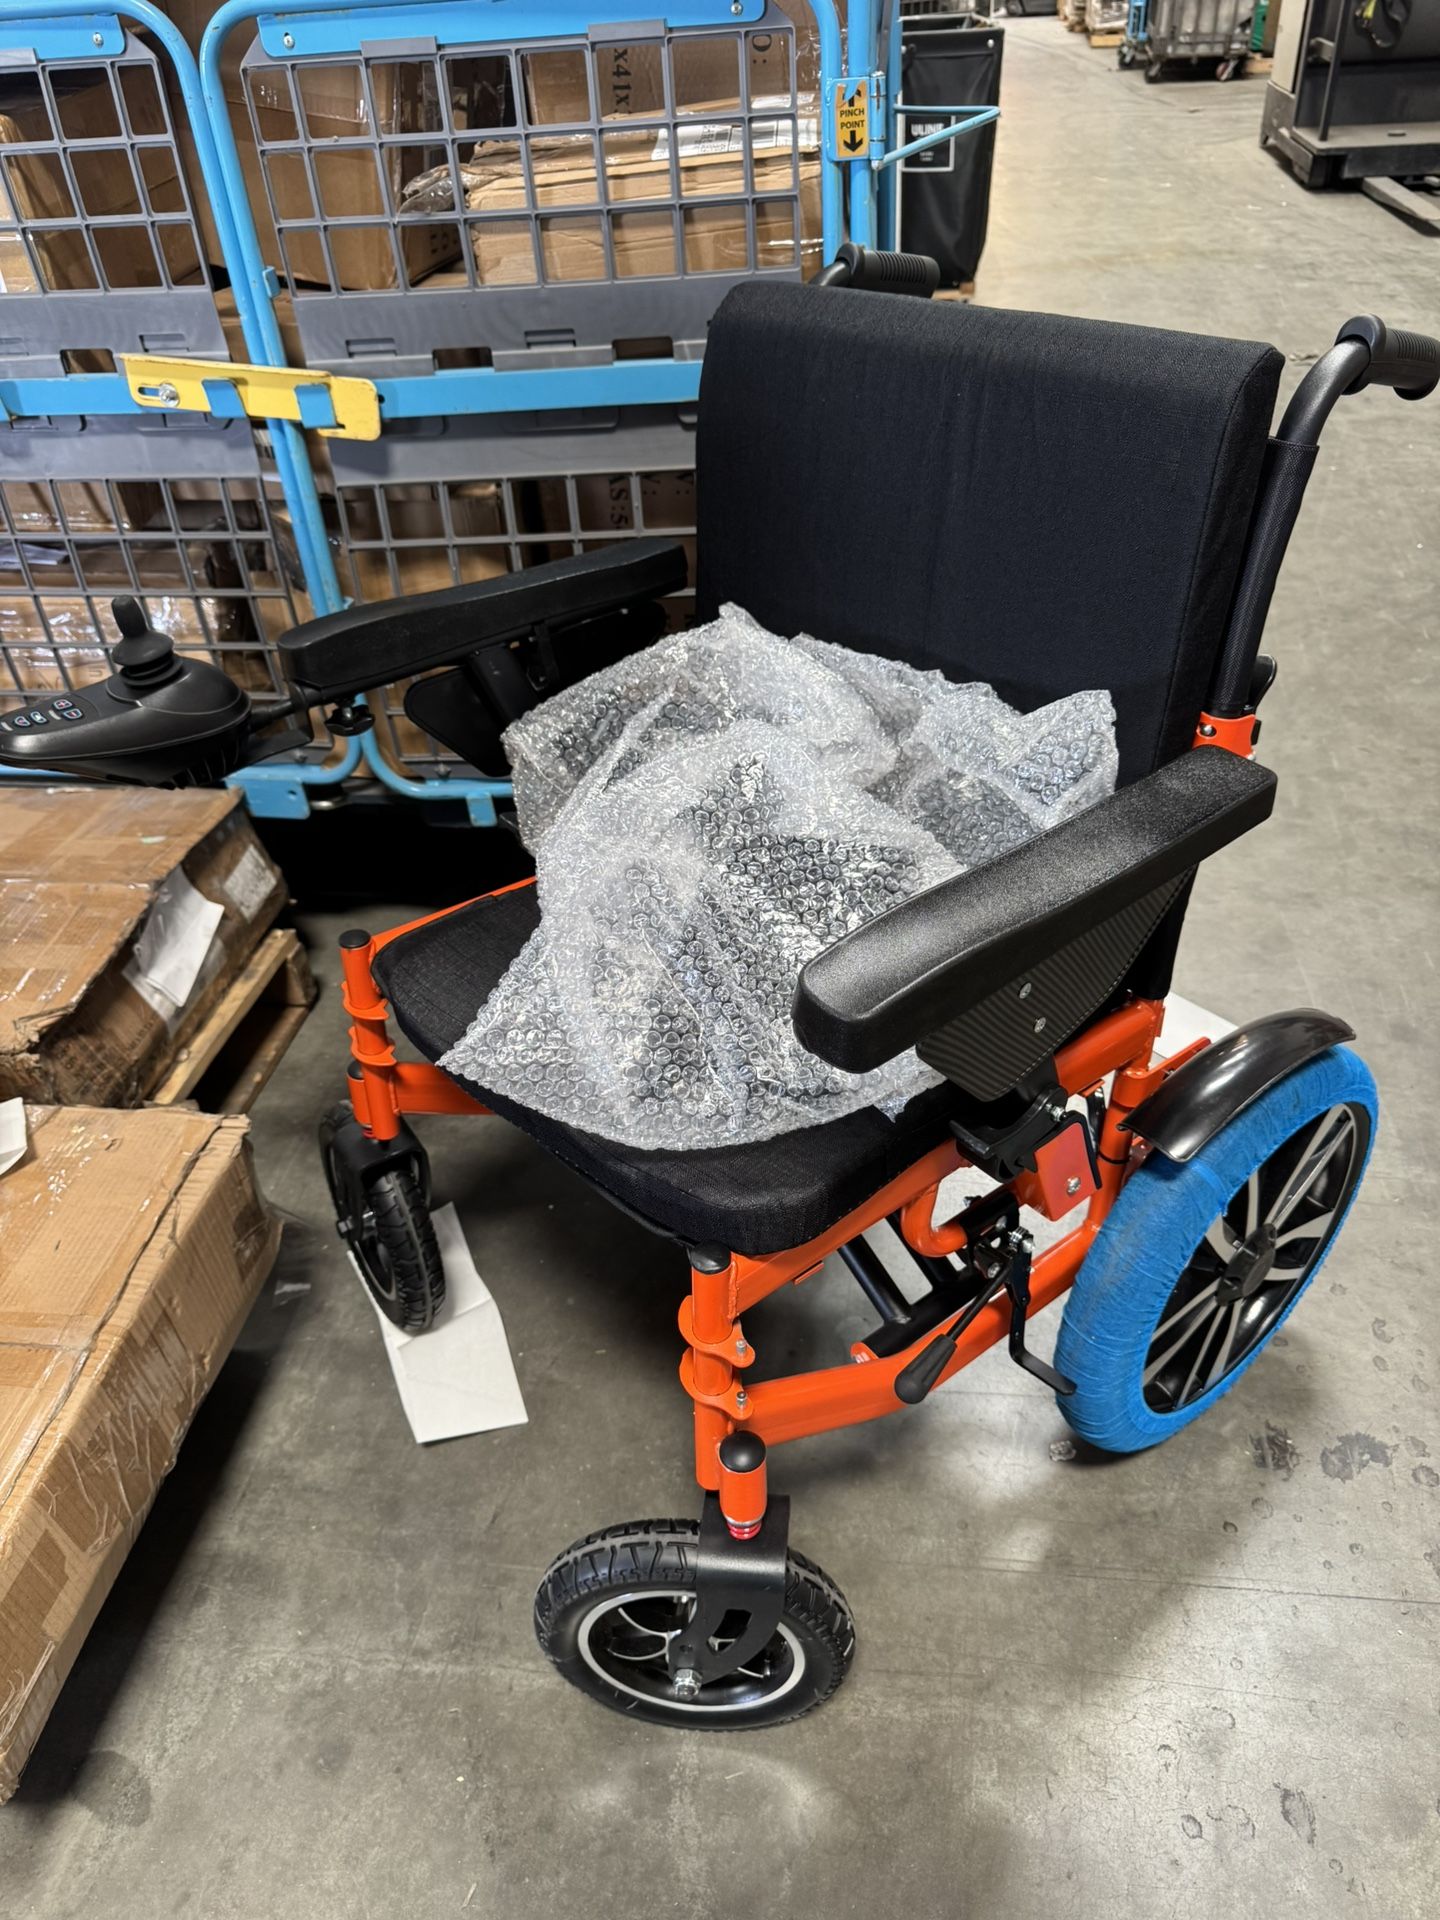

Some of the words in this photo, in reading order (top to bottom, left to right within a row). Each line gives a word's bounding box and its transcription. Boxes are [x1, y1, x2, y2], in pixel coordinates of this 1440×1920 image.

[612, 48, 632, 114] x41x
[840, 108, 865, 118] PINCH
[840, 120, 865, 130] POINT
